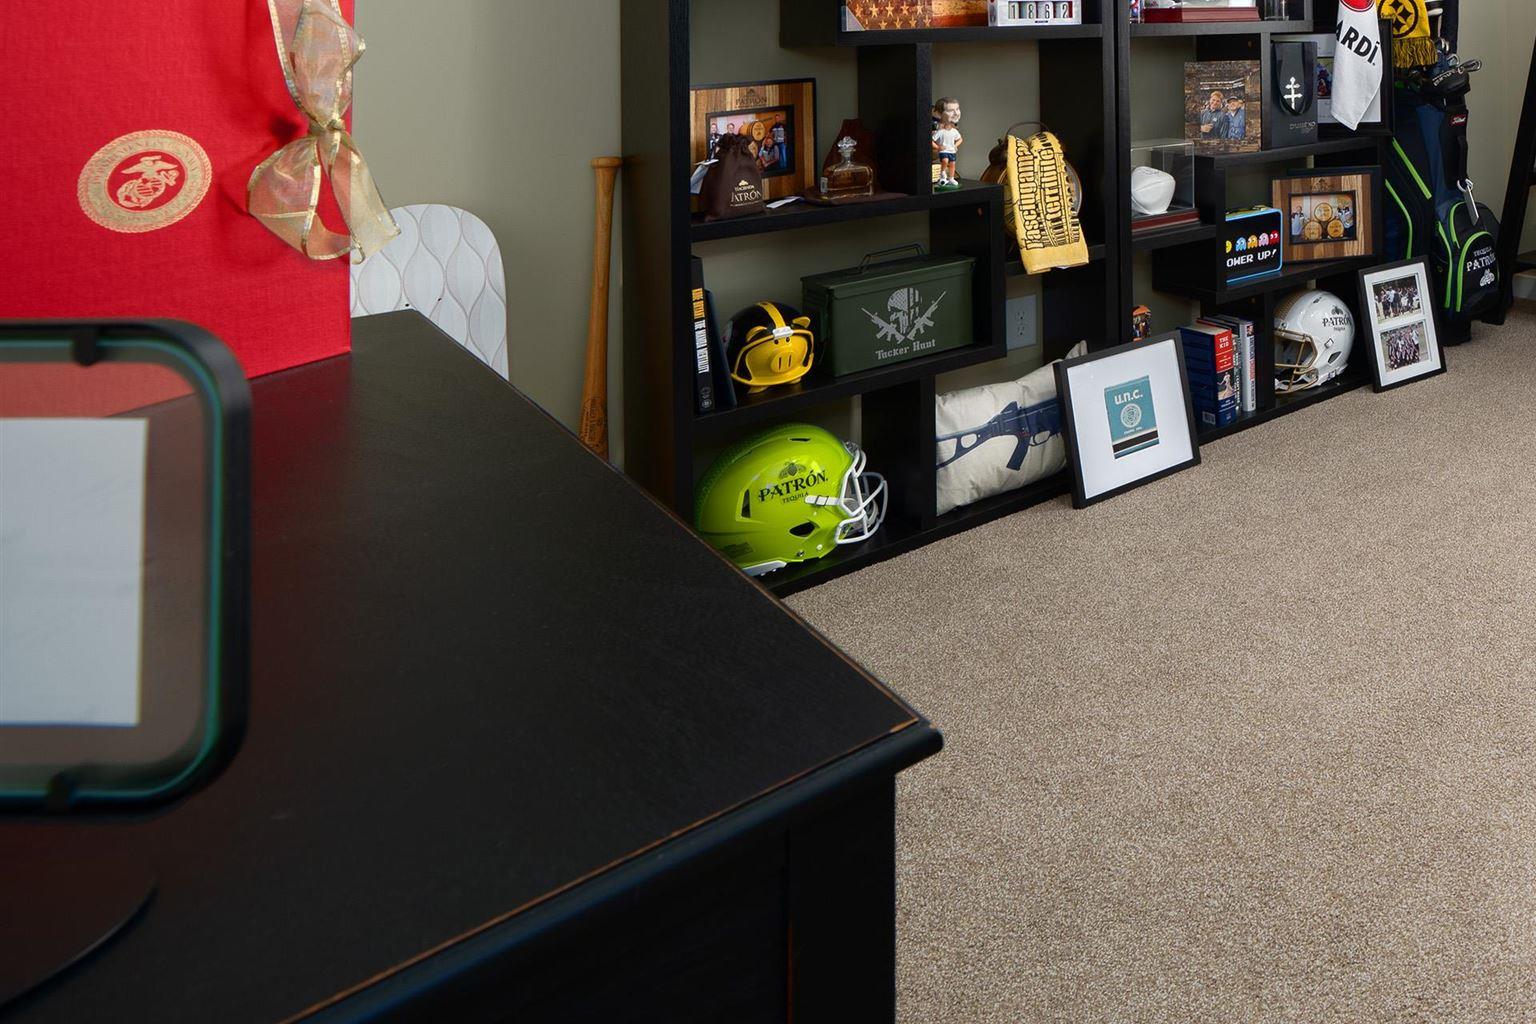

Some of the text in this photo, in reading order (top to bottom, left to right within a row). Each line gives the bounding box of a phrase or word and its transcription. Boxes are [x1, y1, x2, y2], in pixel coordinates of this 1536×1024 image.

[1257, 249, 1277, 261] UP!
[876, 339, 937, 360] Tucker Hunt
[758, 470, 829, 502] PATRÓN
